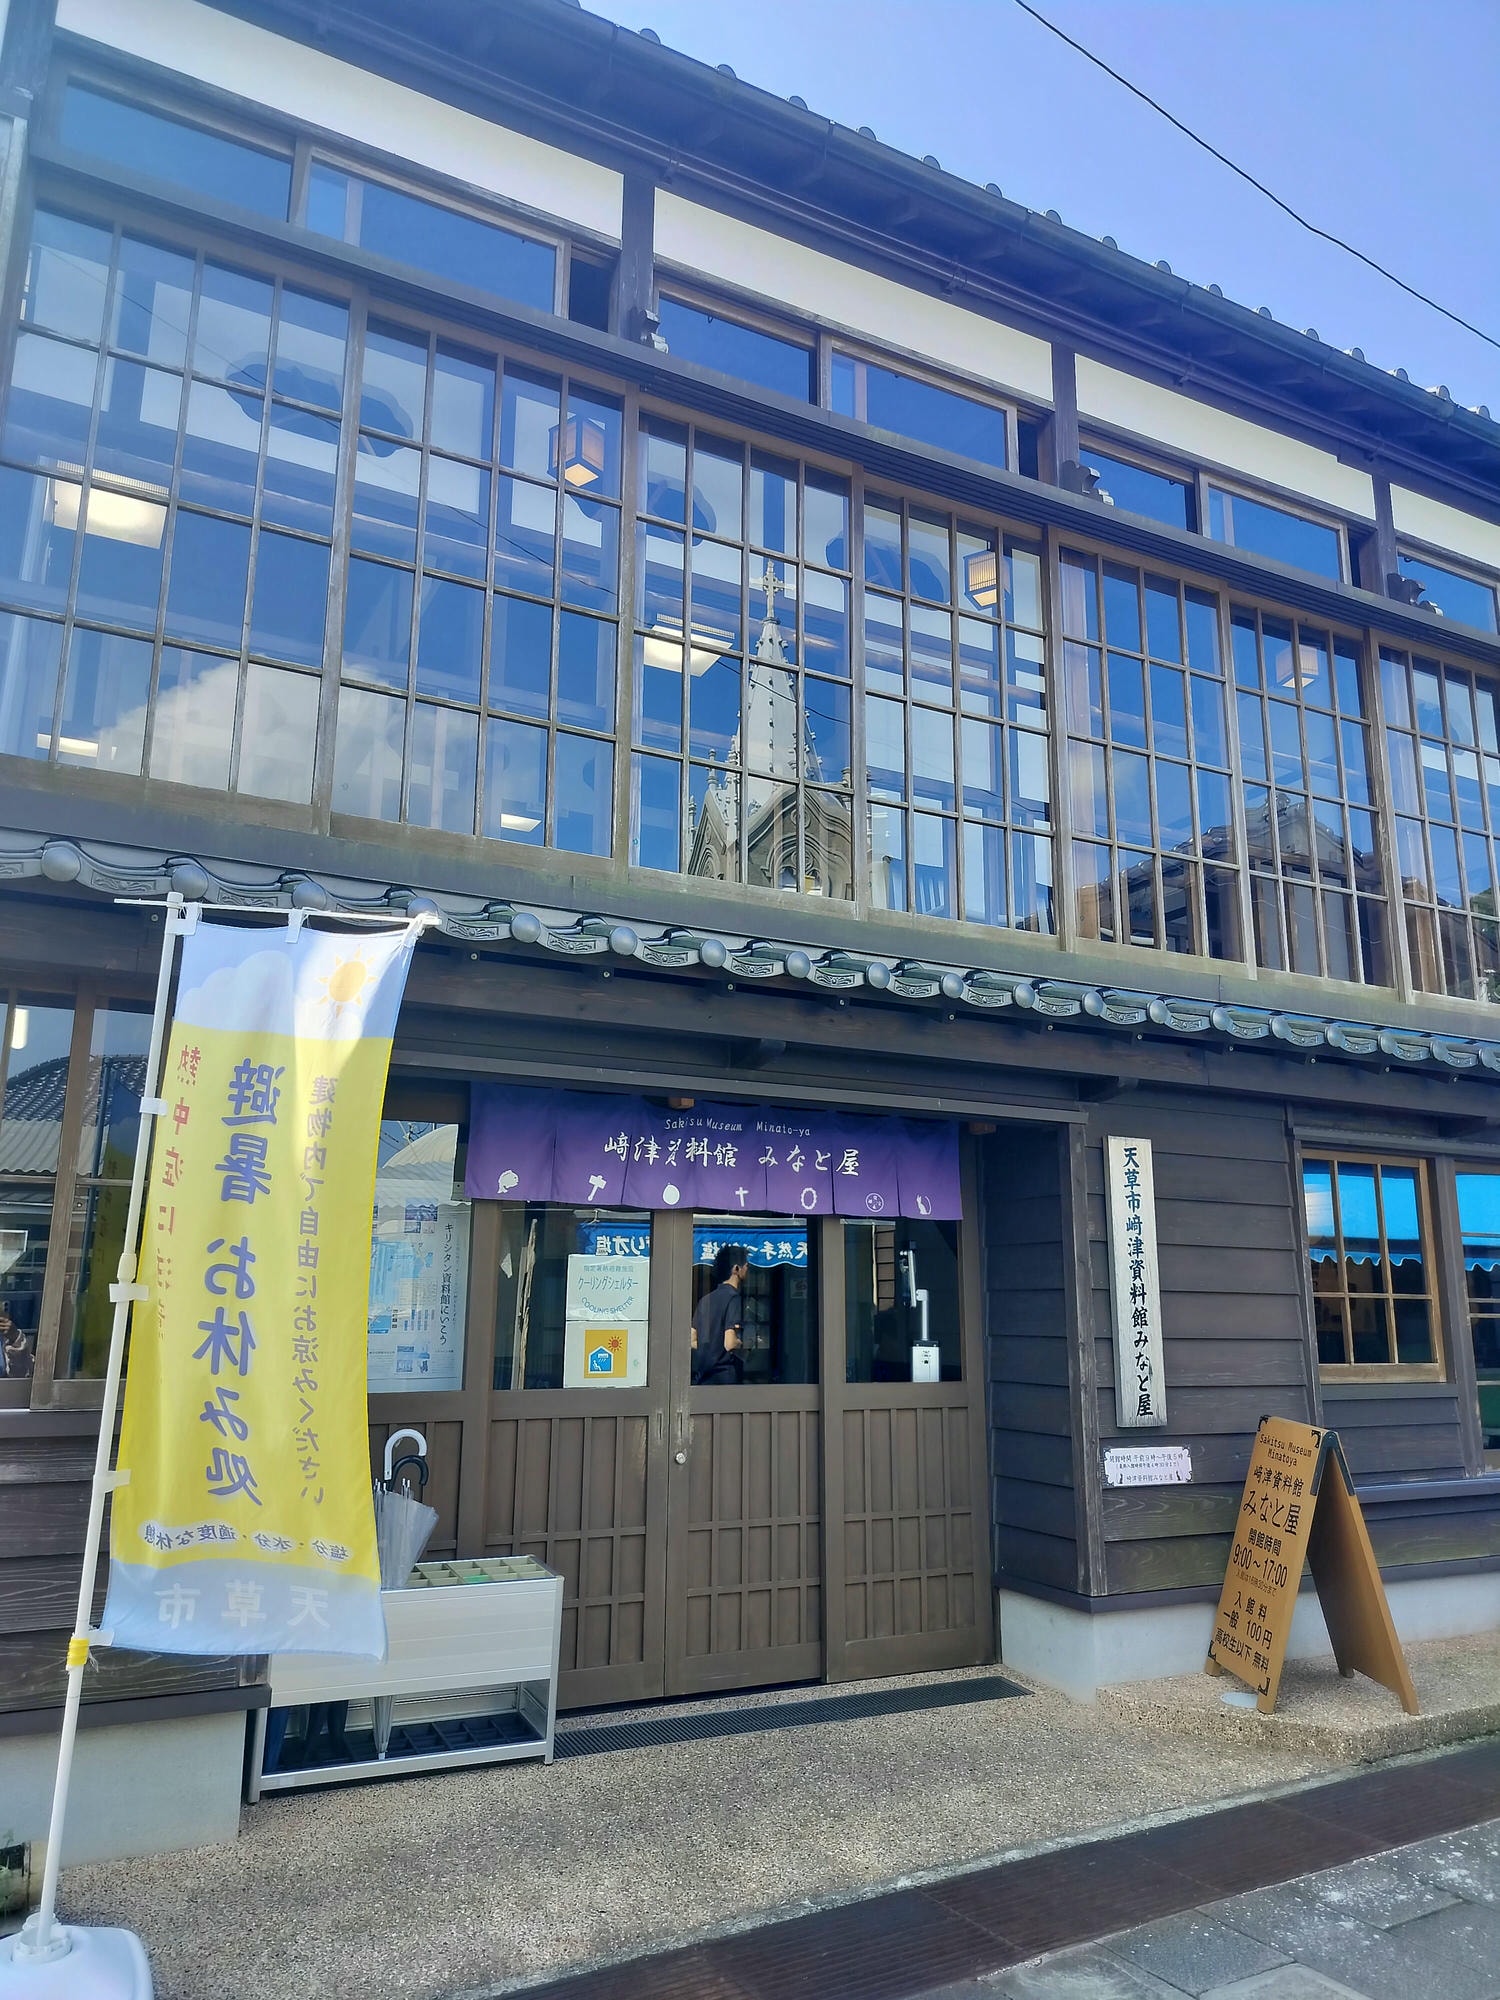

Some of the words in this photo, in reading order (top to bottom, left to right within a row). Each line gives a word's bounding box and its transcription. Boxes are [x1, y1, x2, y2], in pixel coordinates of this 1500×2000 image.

[706, 1118, 743, 1131] Museum
[756, 1121, 811, 1138] Minato-ya
[758, 1144, 860, 1177] みなと屋
[578, 1275, 639, 1290] クーリングシェルター
[581, 1296, 609, 1314] COOLING
[610, 1295, 635, 1315] SHELTER
[1260, 1433, 1285, 1450] Sakitsu
[1287, 1441, 1312, 1458] Museum
[1267, 1448, 1298, 1467] Minatoya
[1243, 1490, 1301, 1536] みなと屋
[1248, 1528, 1282, 1557] 開館時間
[1234, 1591, 1268, 1622] 入館料
[1223, 1610, 1240, 1631] 一般
[1246, 1620, 1273, 1650] 100円
[1214, 1627, 1252, 1662] 高校生以下
[1251, 1651, 1270, 1675] 無料
